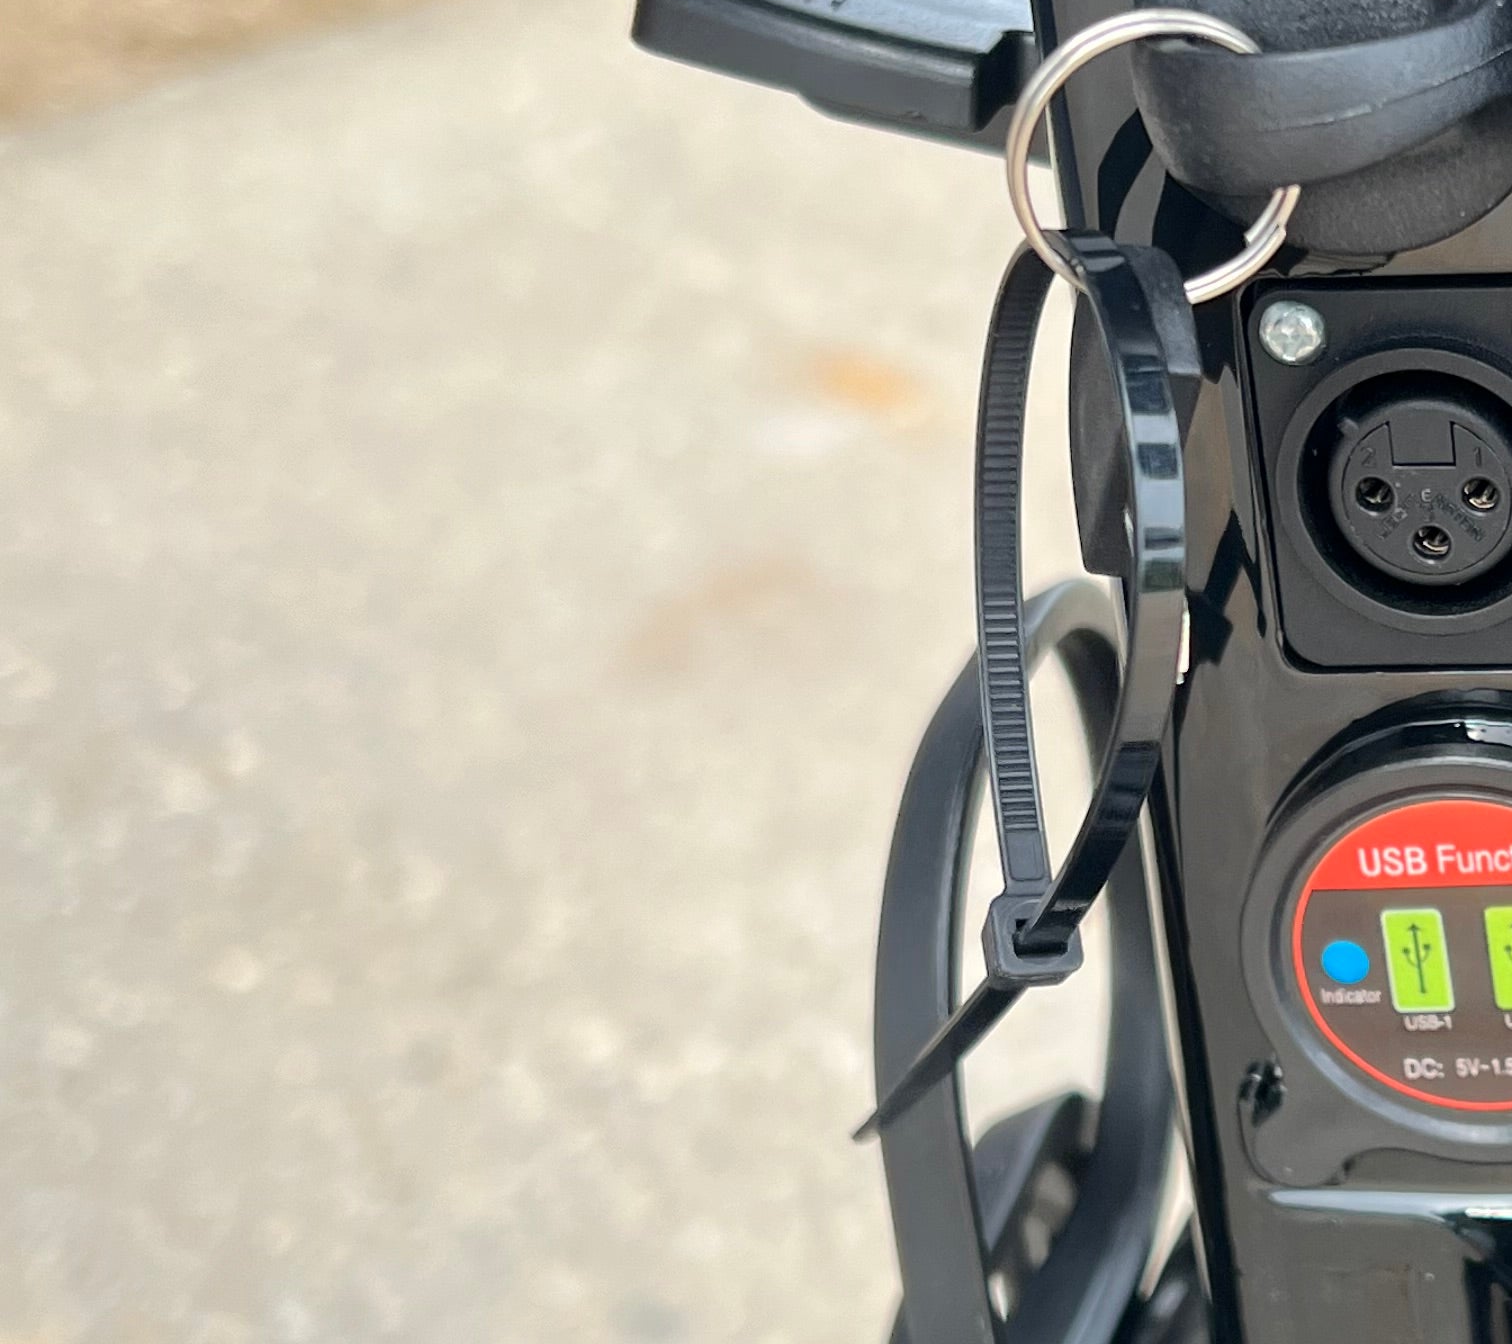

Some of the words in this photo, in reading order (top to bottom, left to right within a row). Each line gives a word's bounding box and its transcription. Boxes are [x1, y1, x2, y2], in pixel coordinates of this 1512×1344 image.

[1357, 845, 1428, 878] USB
[1320, 988, 1382, 1005] Indicator
[1403, 1014, 1453, 1032] USB-1
[1403, 1057, 1446, 1080] DC:
